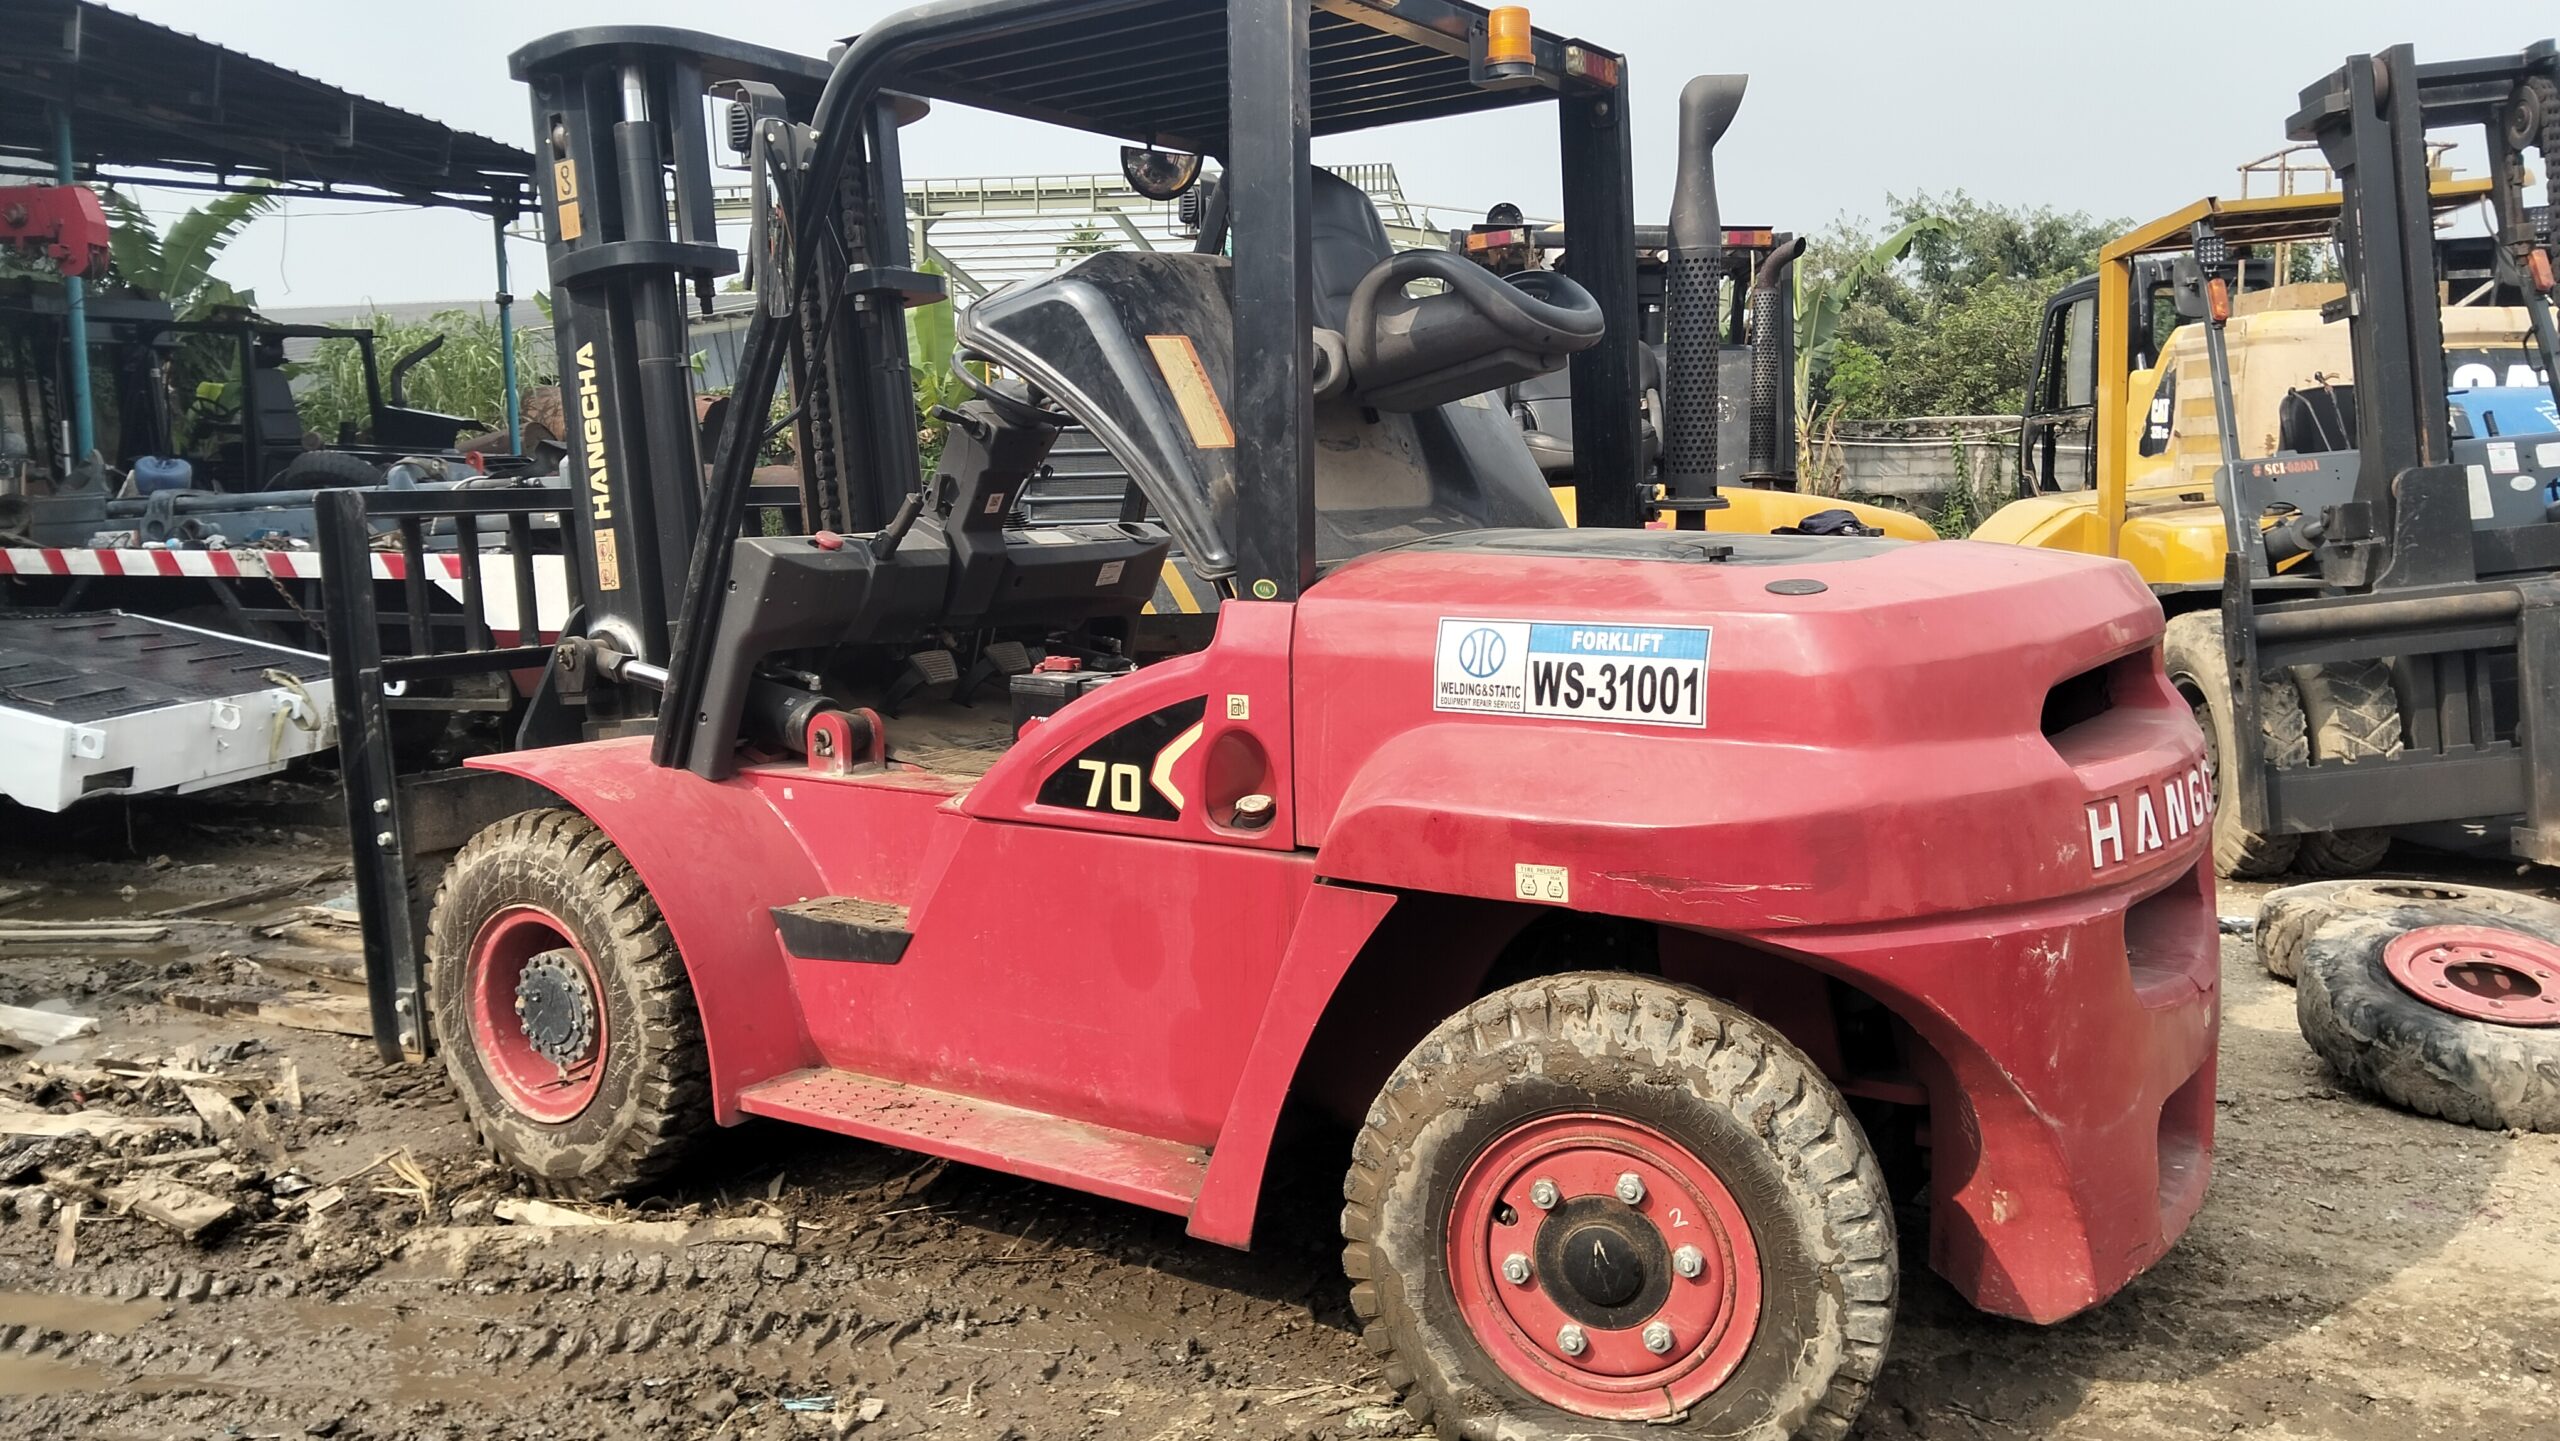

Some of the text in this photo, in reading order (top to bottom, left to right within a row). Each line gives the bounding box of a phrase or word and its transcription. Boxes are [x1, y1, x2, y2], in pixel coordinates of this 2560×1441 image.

[2151, 398, 2170, 423] CAT
[576, 341, 612, 520] HANGCHA
[1571, 630, 1663, 653] FORKLIFT
[1440, 681, 1521, 699] WELDING&STATIC
[1533, 660, 1699, 716] WS-31001
[1440, 697, 1521, 710] EQUIPMENT REPAIR SERVICES
[1078, 759, 1141, 812] 70
[1668, 1208, 1689, 1227] 2
